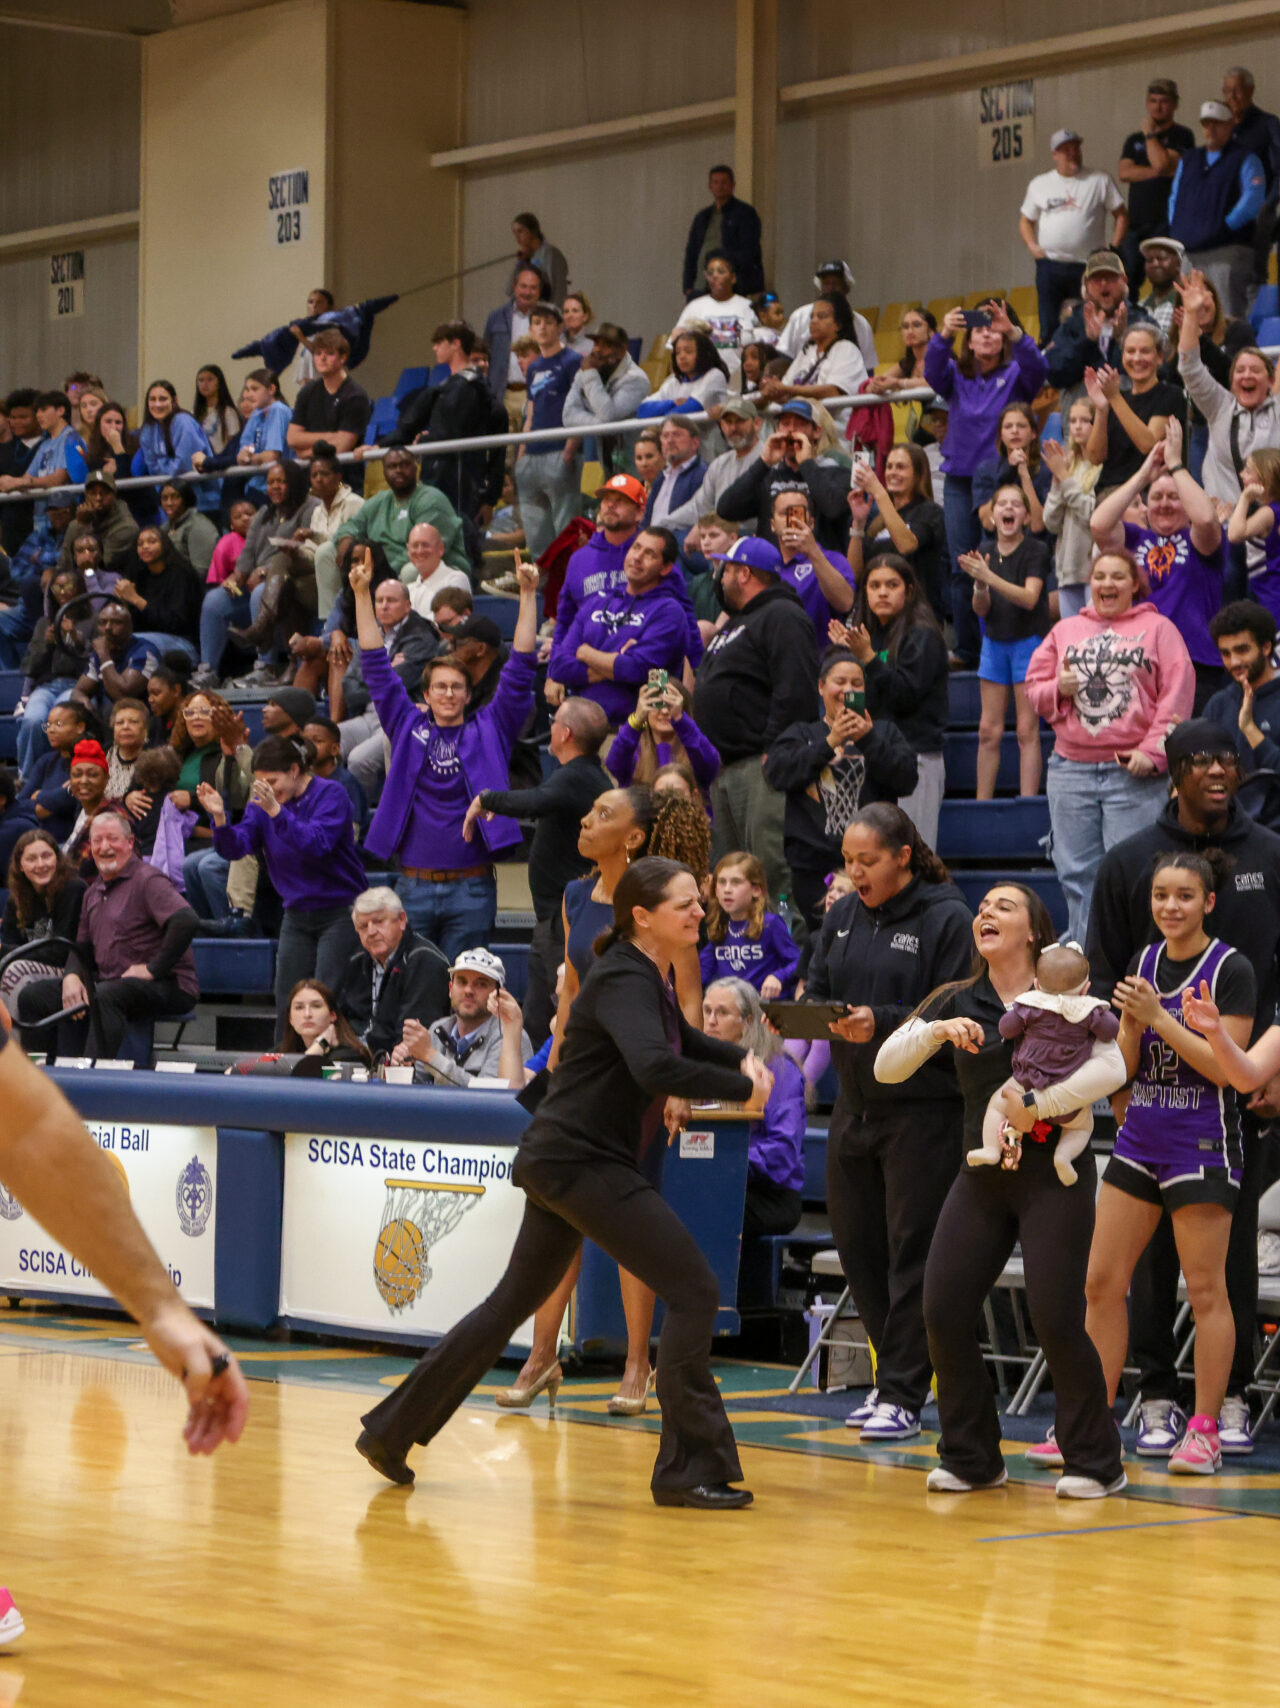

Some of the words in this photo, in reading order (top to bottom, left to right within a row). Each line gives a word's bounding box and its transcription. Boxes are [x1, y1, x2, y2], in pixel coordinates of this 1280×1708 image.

[980, 78, 1034, 123] SECTION
[991, 124, 1023, 161] 205
[268, 170, 308, 210] SECTION
[277, 211, 301, 243] 203
[50, 251, 84, 284] SECTION
[57, 287, 75, 314] 201
[120, 1128, 150, 1151] Ball
[308, 1138, 363, 1166] SCISA
[370, 1144, 415, 1171] State
[19, 1249, 66, 1275] SCISA
